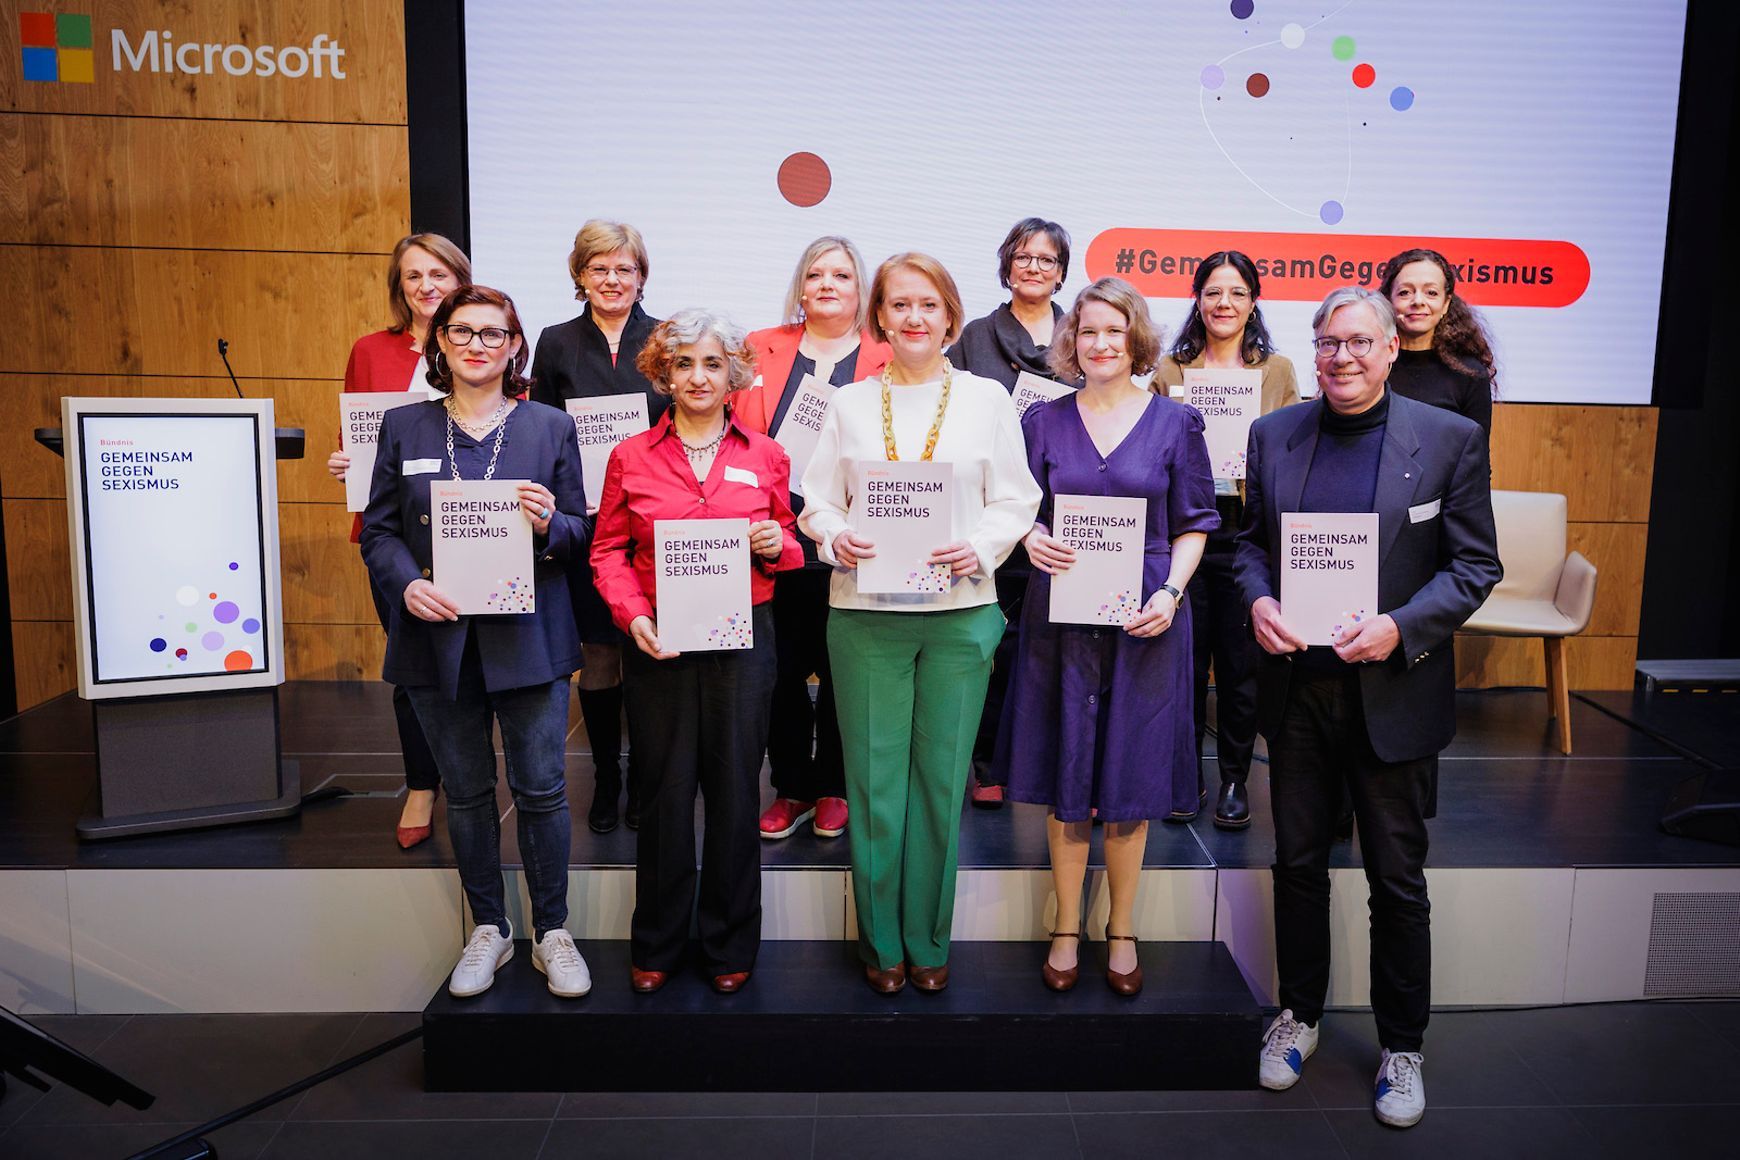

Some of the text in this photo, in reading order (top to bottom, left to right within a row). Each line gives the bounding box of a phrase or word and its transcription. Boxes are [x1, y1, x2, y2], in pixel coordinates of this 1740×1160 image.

[111, 28, 346, 79] Microsoft
[1115, 248, 1553, 285] #GemsamGegexismus
[1191, 386, 1253, 396] GEMEINSAM
[1191, 396, 1226, 406] GEGEN
[350, 411, 383, 421] GEME
[575, 410, 640, 424] GEMEINSAM
[798, 402, 824, 421] GEGE
[1197, 407, 1242, 416] EXISMUS
[350, 423, 381, 432] GEGE
[793, 412, 821, 432] SEXIS
[577, 424, 613, 435] GEGEN
[100, 438, 134, 446] Bündnis
[351, 434, 378, 444] SEXI
[101, 452, 193, 463] GEMEINSAM
[101, 466, 153, 477] GEGEN
[102, 479, 179, 491] SEXISMUS
[868, 481, 943, 492] GEMEINSAM
[867, 494, 909, 505] GEGEN
[441, 501, 520, 512] GEMEINSAM
[867, 507, 930, 518] SEXISMUS
[441, 514, 486, 525] GEGEN
[1063, 514, 1136, 527] GEMEINSAM
[441, 527, 508, 538] SEXISMUS
[1062, 527, 1103, 538] GEGEN
[664, 538, 740, 551] GEMEINSAM
[1291, 533, 1368, 545] GEMEINSAM
[1291, 546, 1333, 557] GEGEN
[665, 553, 707, 564] GEGEN
[1290, 559, 1355, 570] SEXISMUS
[665, 564, 729, 577] SEXISMUS
